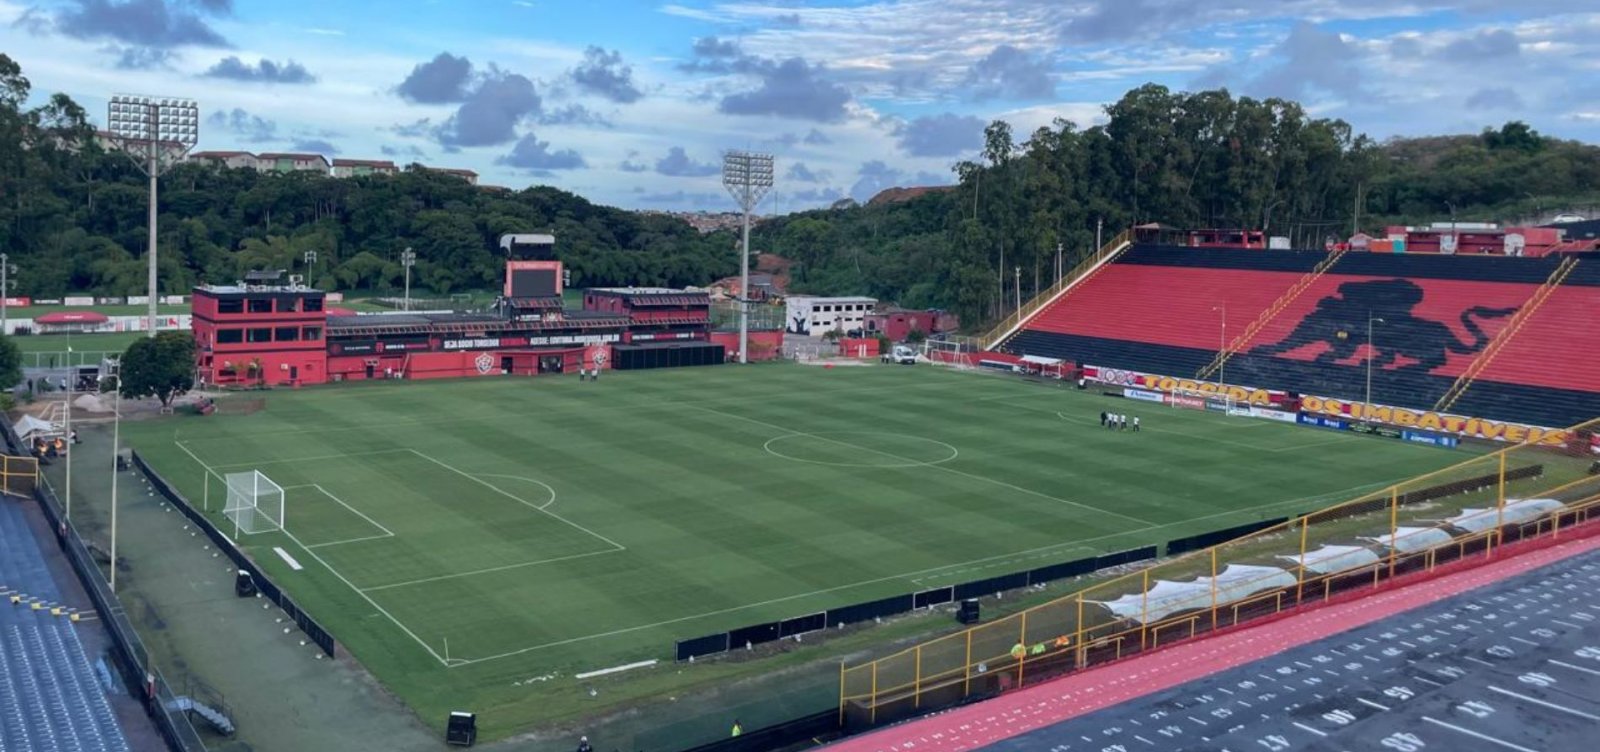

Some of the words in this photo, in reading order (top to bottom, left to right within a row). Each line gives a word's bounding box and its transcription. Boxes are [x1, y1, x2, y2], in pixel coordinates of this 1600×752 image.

[1143, 375, 1270, 405] TORCIDA
[1302, 395, 1342, 415] OS
[1517, 671, 1557, 687] 46
[1383, 685, 1415, 700] 45
[1321, 709, 1357, 725] 46
[1456, 700, 1496, 718] 47
[1257, 733, 1290, 751] 47
[1381, 732, 1426, 752] 48
